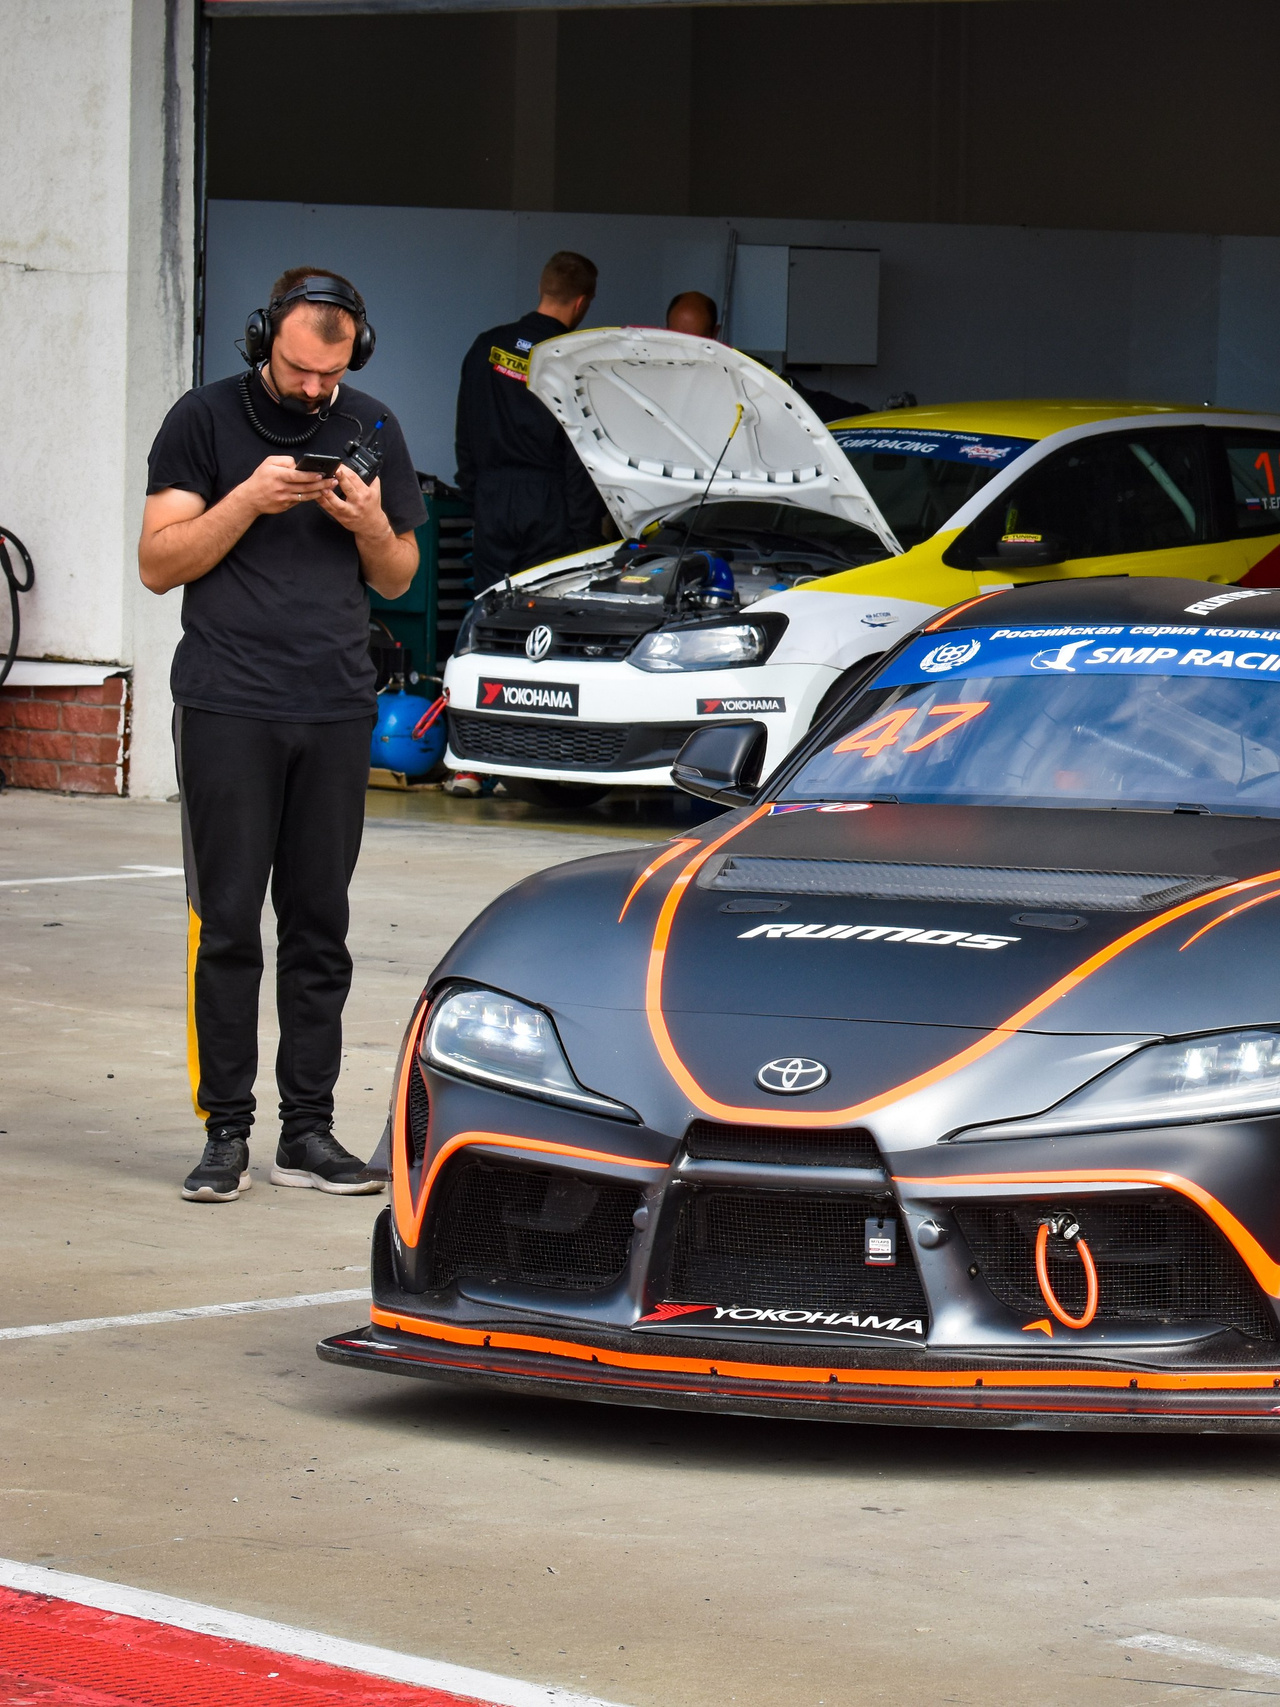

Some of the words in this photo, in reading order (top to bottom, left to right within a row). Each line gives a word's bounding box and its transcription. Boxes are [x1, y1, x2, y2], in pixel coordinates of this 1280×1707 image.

[841, 438, 877, 449] SMP
[873, 439, 939, 454] RACING
[988, 626, 1122, 641] Российская
[1129, 626, 1195, 638] серия
[1084, 647, 1178, 664] SMP
[502, 686, 573, 709] YOKOHAMA
[721, 699, 779, 711] YOKOHAMA
[832, 701, 990, 758] 47
[737, 923, 1022, 950] RUMOS
[713, 1306, 923, 1335] YOKOHAMA
